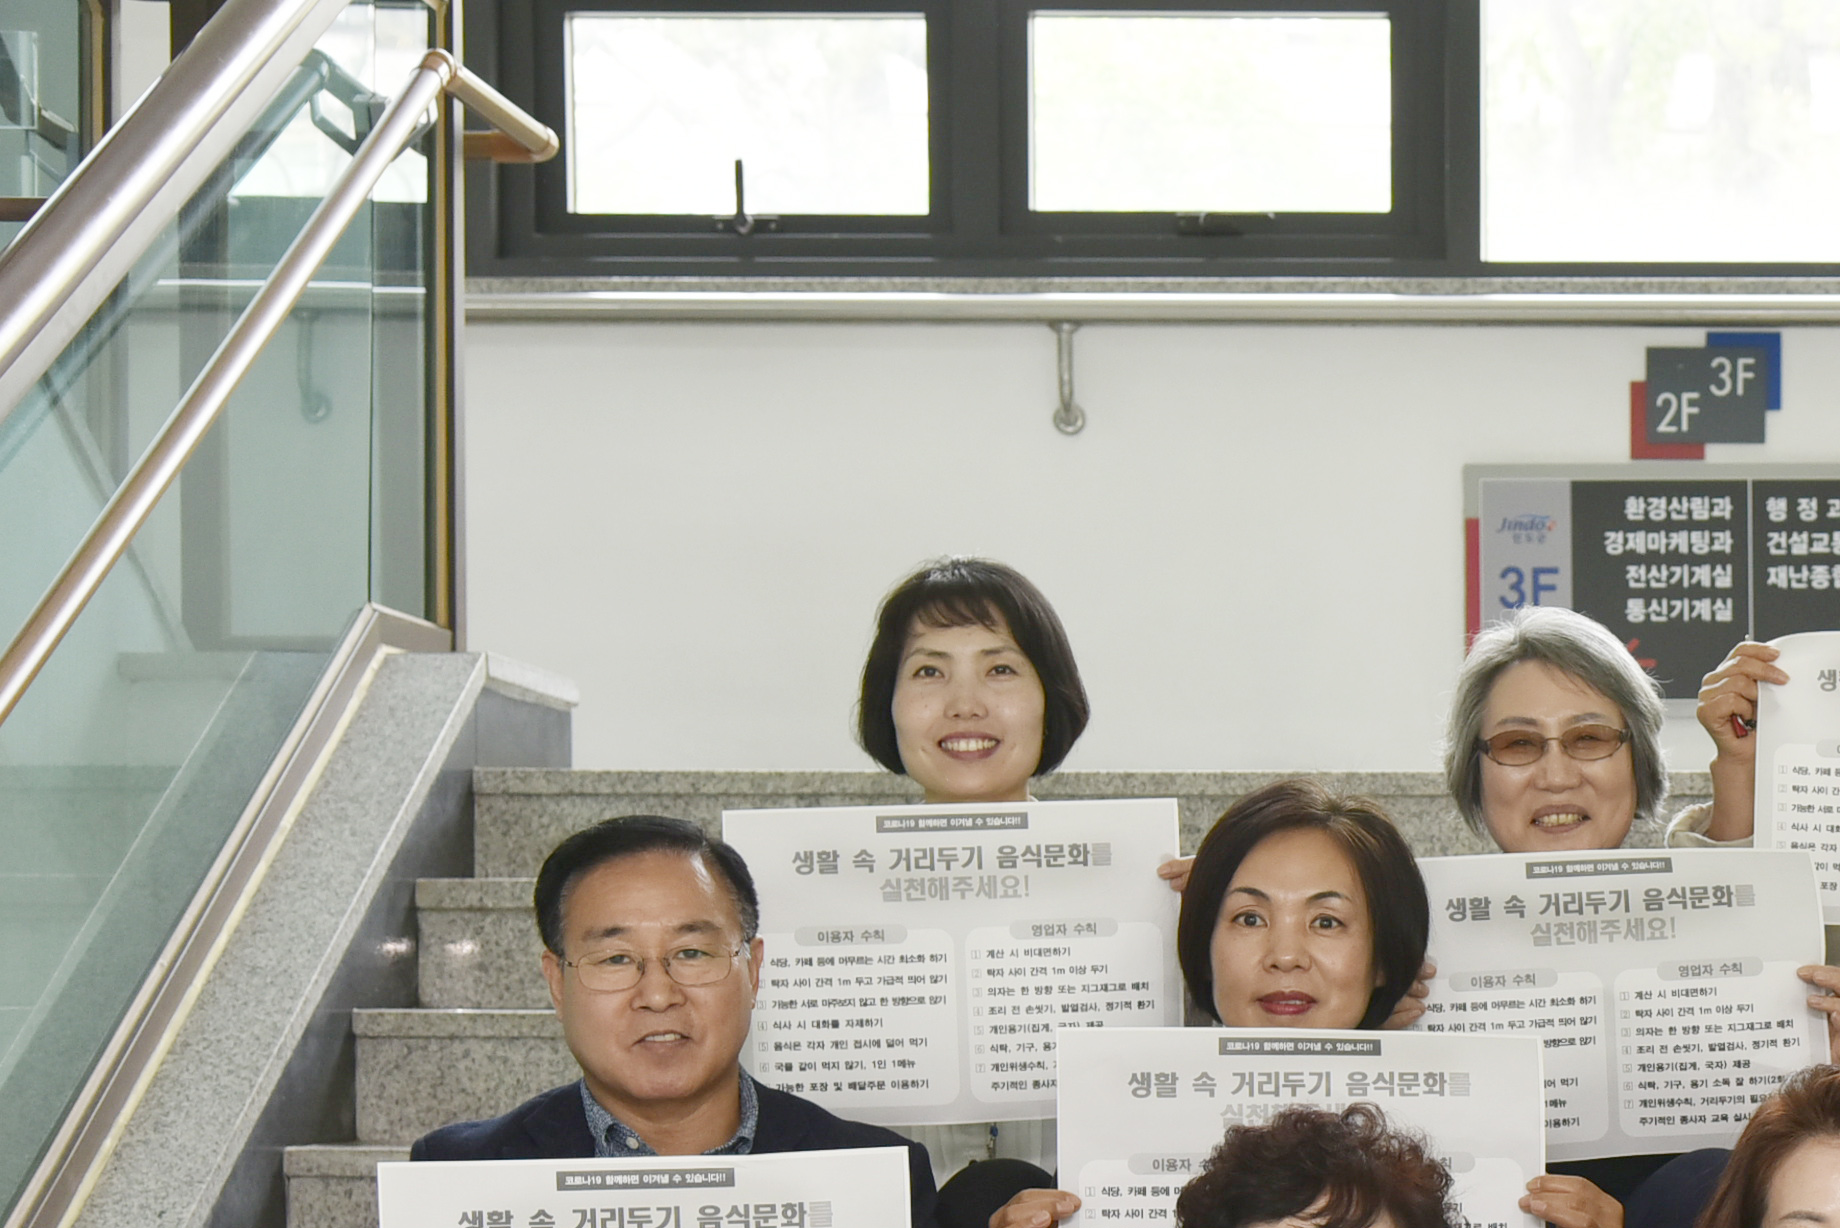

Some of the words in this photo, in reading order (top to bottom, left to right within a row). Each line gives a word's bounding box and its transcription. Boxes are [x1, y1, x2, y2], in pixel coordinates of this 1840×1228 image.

[1709, 357, 1756, 397] 3F
[1656, 391, 1700, 433] 2F
[1624, 496, 1733, 520] 환경산림과
[1604, 530, 1733, 555] 경제마케팅과
[1499, 566, 1559, 608] 3F
[1625, 564, 1733, 588] 전산기계실
[1624, 598, 1733, 623] 통신기계실
[792, 850, 840, 875] 생활
[852, 849, 876, 873] 속
[889, 846, 983, 872] 거리두기
[880, 875, 1029, 902] 실천해주세요!
[1446, 897, 1491, 922] 생활
[1504, 895, 1526, 918] 속
[1539, 889, 1630, 915] 거리두기
[1642, 885, 1755, 912] 음식문화를
[818, 930, 854, 943] 이용자
[861, 929, 884, 942] 수칙
[1032, 923, 1067, 937] 영업자
[1073, 922, 1096, 935] 수칙
[1530, 917, 1676, 947] 실천해주세요!
[1471, 975, 1506, 988] 이용자
[1513, 973, 1535, 986] 수칙
[1678, 964, 1713, 977] 영업자
[1719, 962, 1742, 975] 수칙
[1128, 1072, 1179, 1098] 생활
[1192, 1072, 1217, 1098] 속
[1231, 1071, 1331, 1097] 거리두기
[1153, 1158, 1191, 1172] 이용자
[565, 1175, 601, 1185] 코로나19
[606, 1175, 639, 1185] 함께하면
[643, 1174, 669, 1184] 이겨낼
[672, 1174, 682, 1183] 수
[685, 1173, 725, 1183] 있습니다!!
